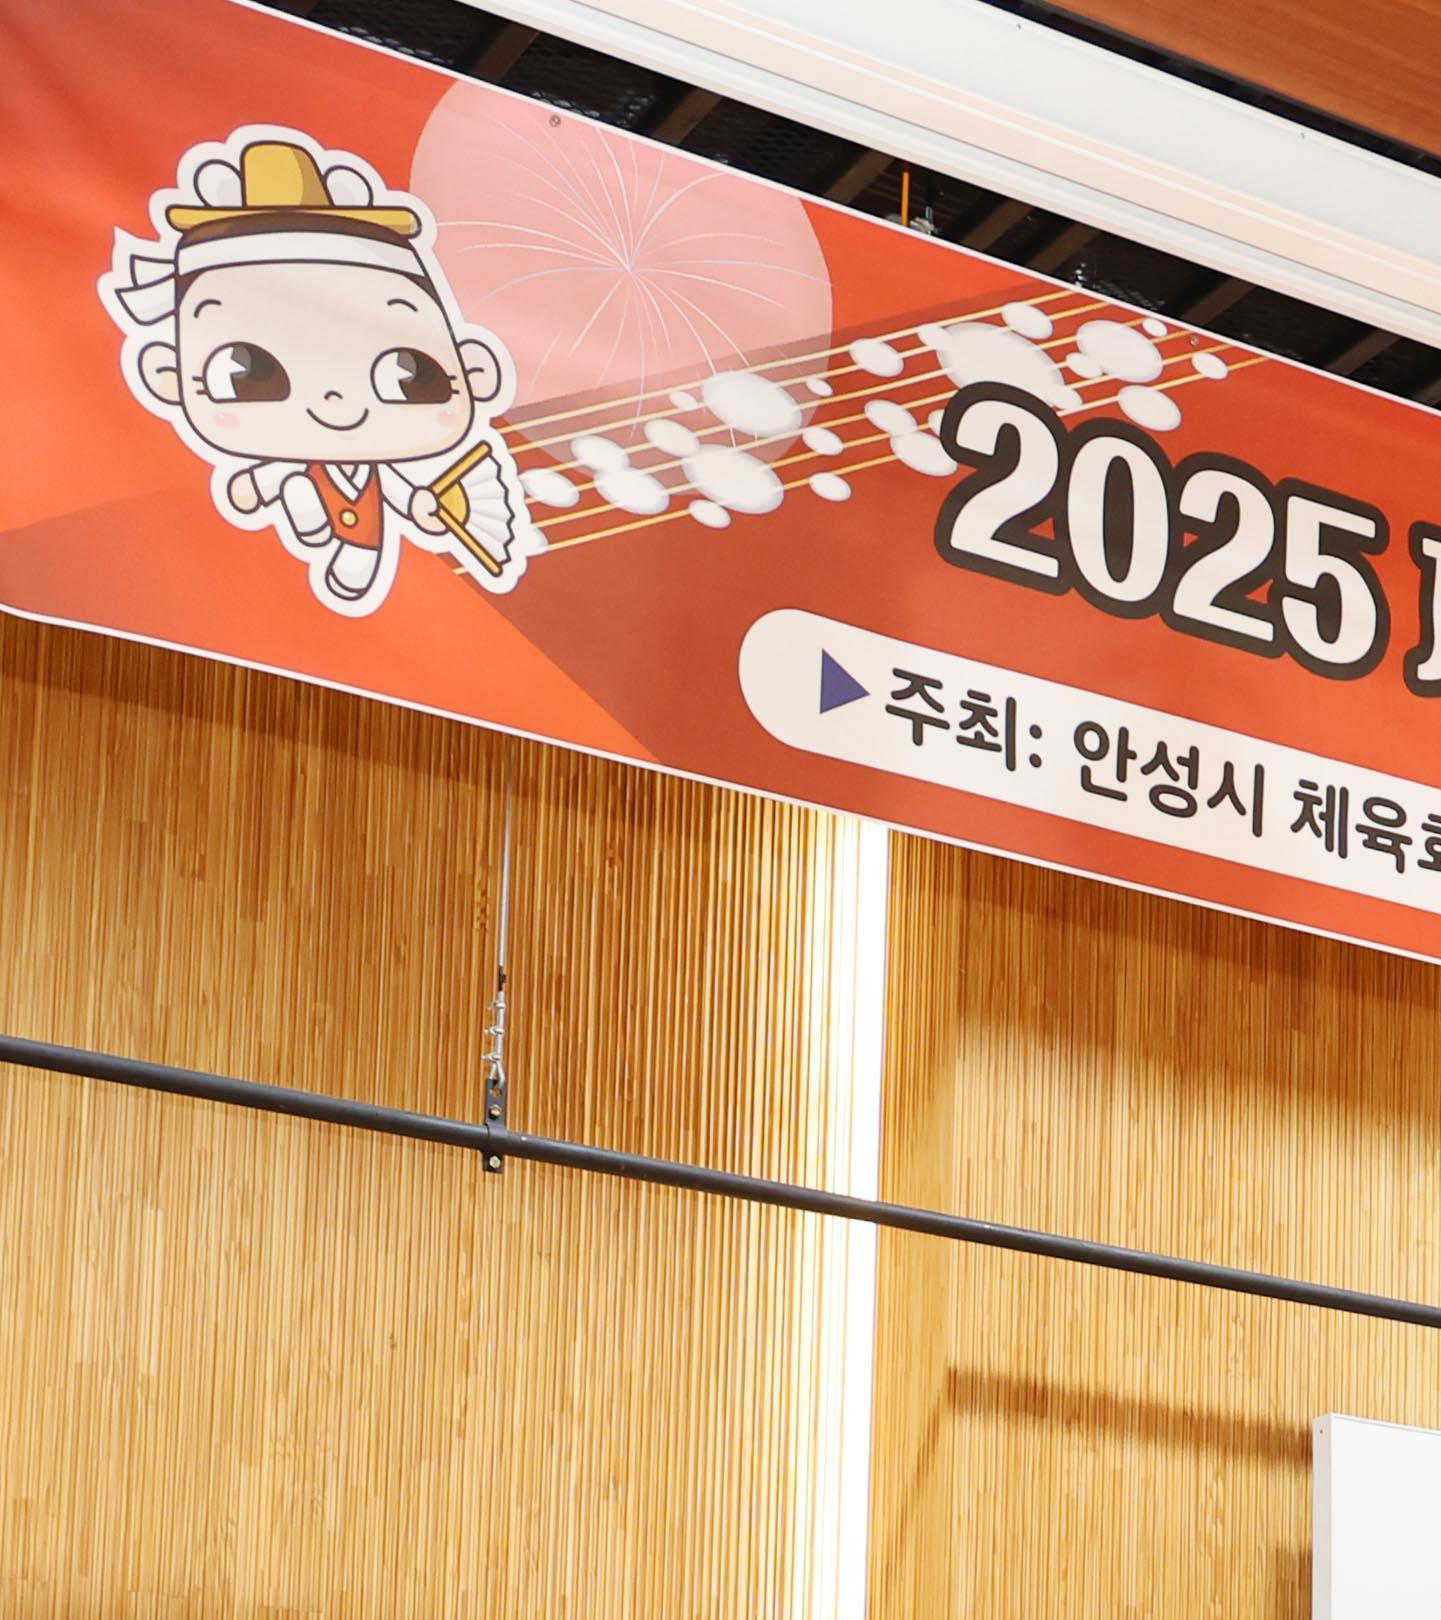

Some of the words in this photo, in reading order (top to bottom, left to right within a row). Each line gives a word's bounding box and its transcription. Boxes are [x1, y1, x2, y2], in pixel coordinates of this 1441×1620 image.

[946, 396, 1378, 668] 2025
[883, 665, 1046, 771] 주최:
[1070, 718, 1267, 837] 안성시
